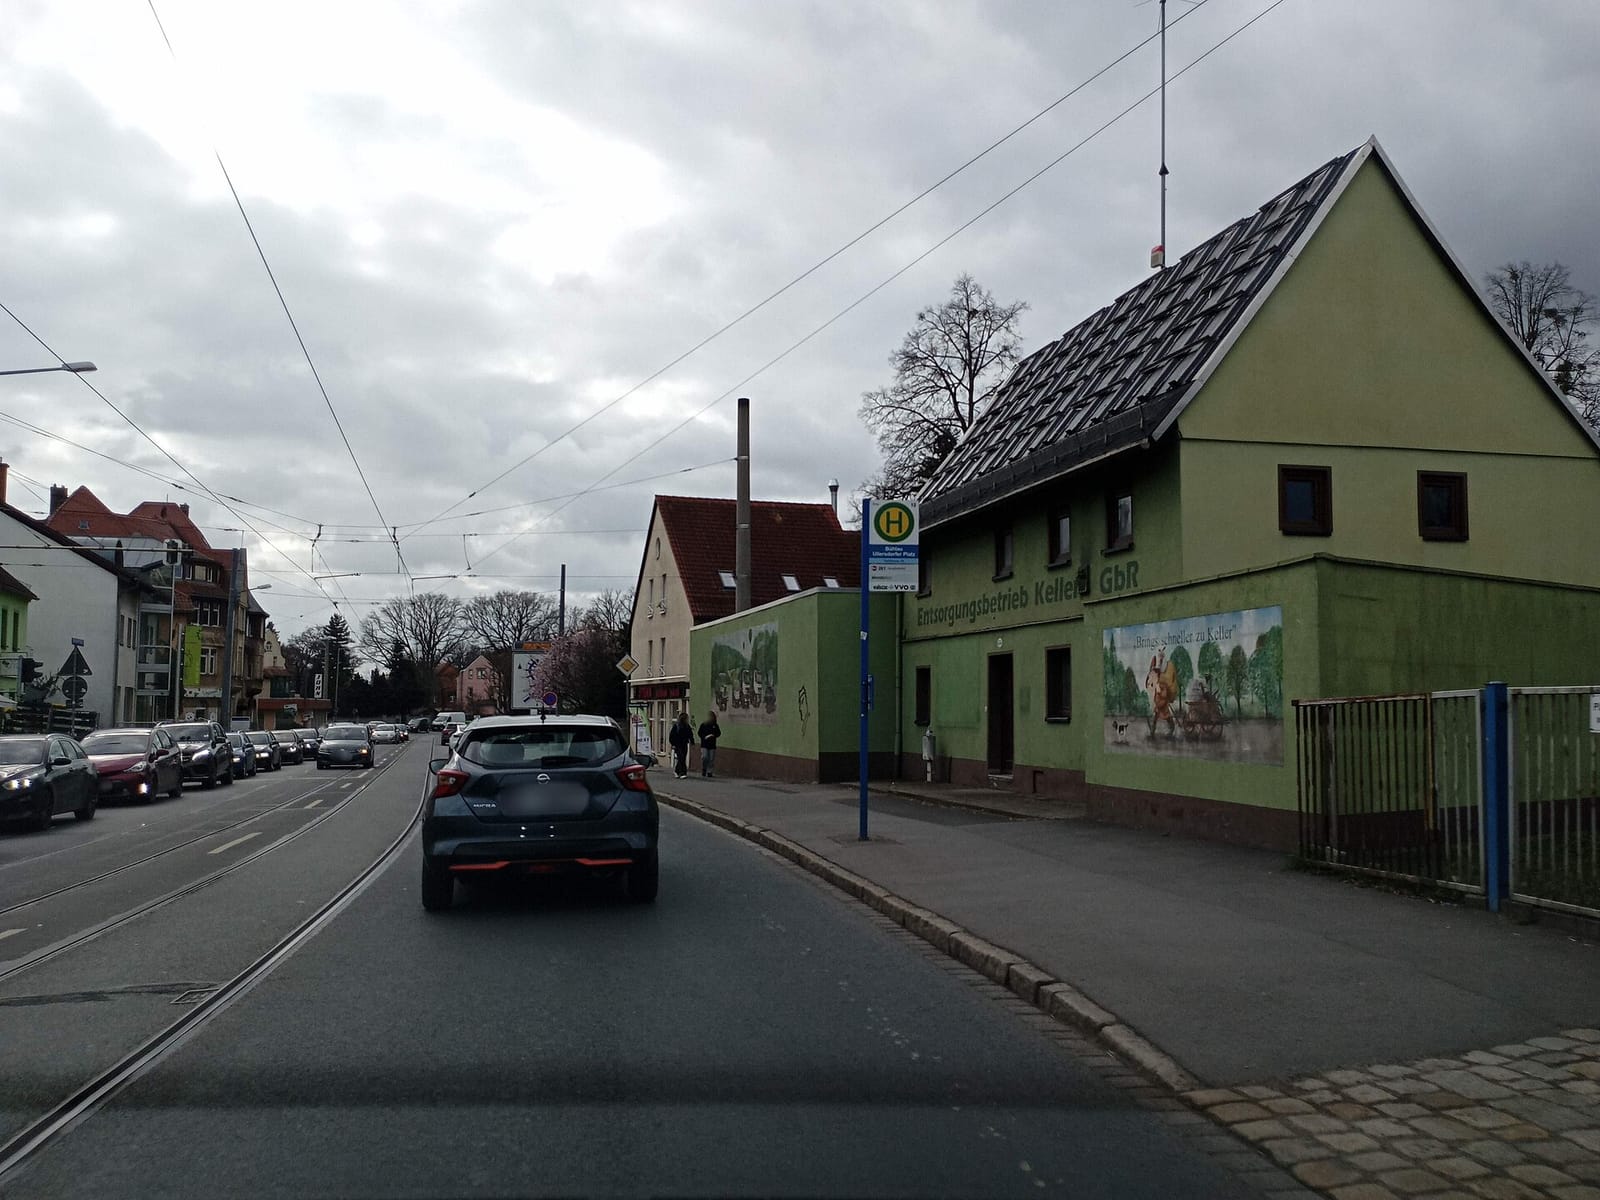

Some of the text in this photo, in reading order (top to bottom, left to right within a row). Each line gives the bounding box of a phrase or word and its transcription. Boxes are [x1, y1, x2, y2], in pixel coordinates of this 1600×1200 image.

[886, 511, 902, 533] H
[917, 560, 1138, 626] Entsorgungsbetrieb Keller GbR
[1196, 631, 1205, 642] zu
